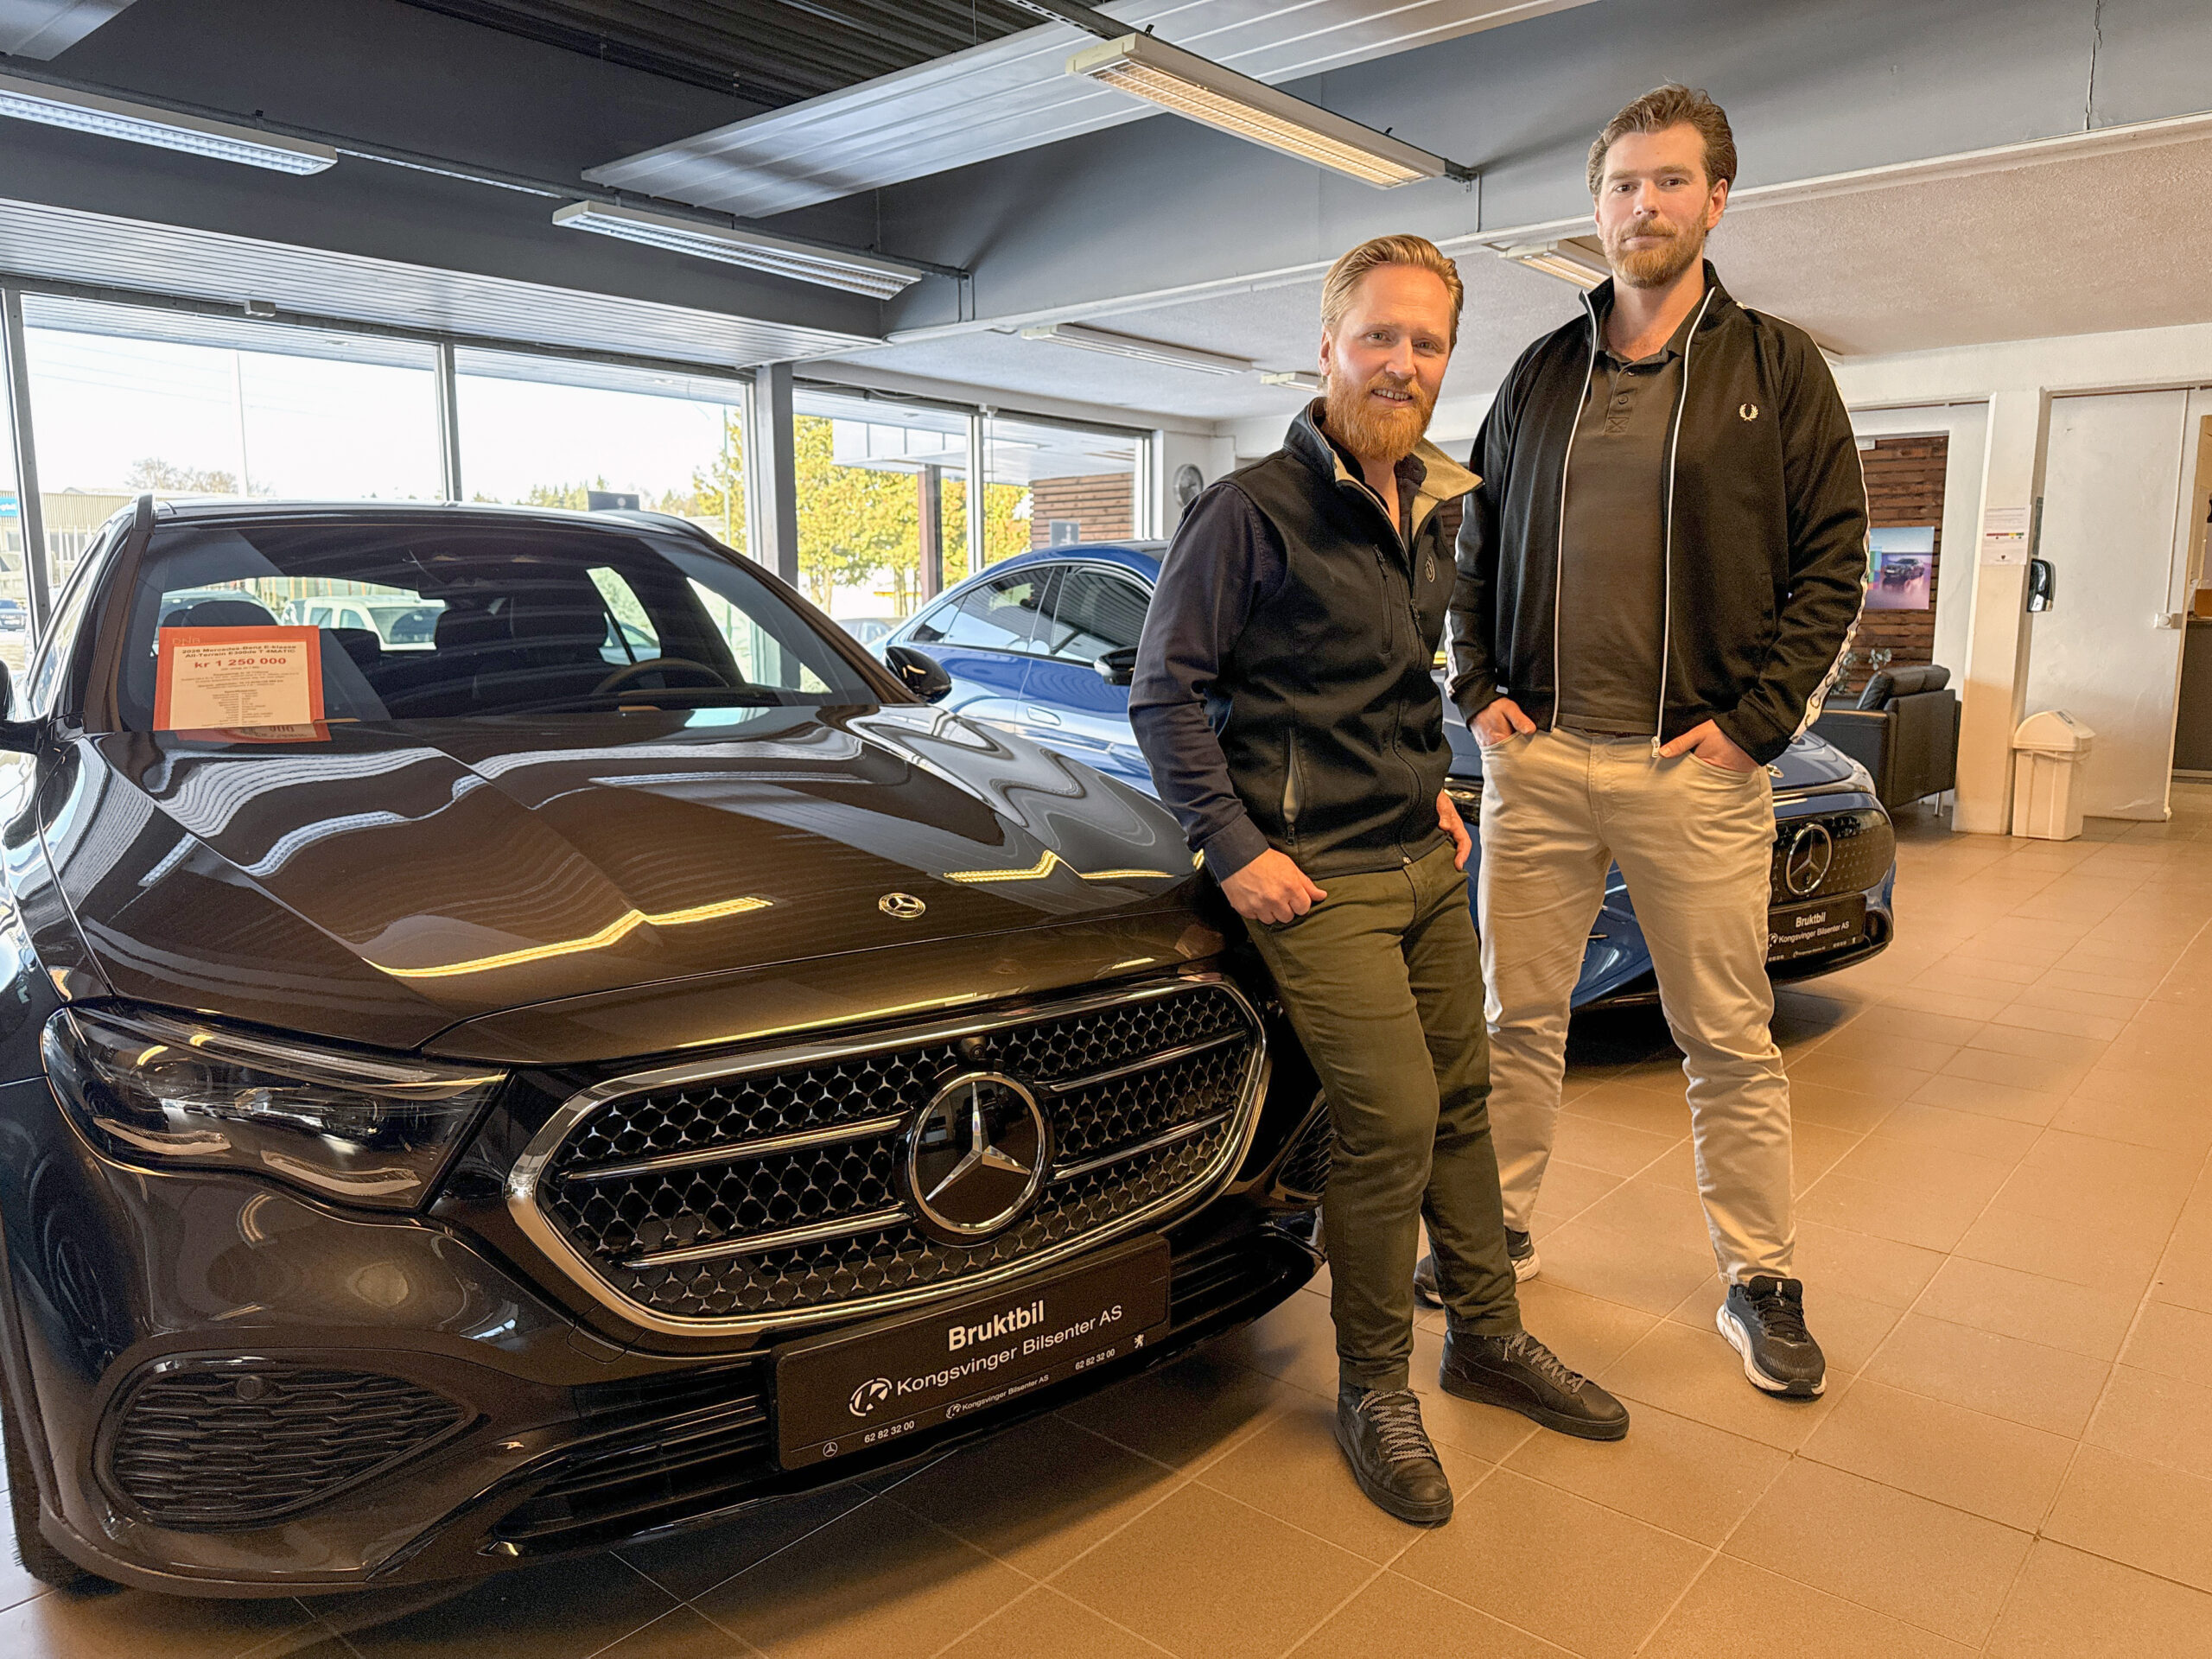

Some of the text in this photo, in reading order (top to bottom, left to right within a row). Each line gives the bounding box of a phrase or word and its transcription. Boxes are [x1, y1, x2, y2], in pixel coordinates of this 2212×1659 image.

[228, 658, 255, 666] 250
[1796, 912, 1827, 928] Bruktbil
[1779, 921, 1849, 944] Kongsvinger Bilsenter AS
[949, 1300, 1044, 1351] Bruktbil
[897, 1305, 1122, 1395] Kongsvinger Bilsenter AS
[1075, 1349, 1116, 1370] 62 82 32 00
[962, 1374, 1049, 1411] Kongsvinger Bilsenter AS
[864, 1421, 915, 1443] 62 82 32 00
